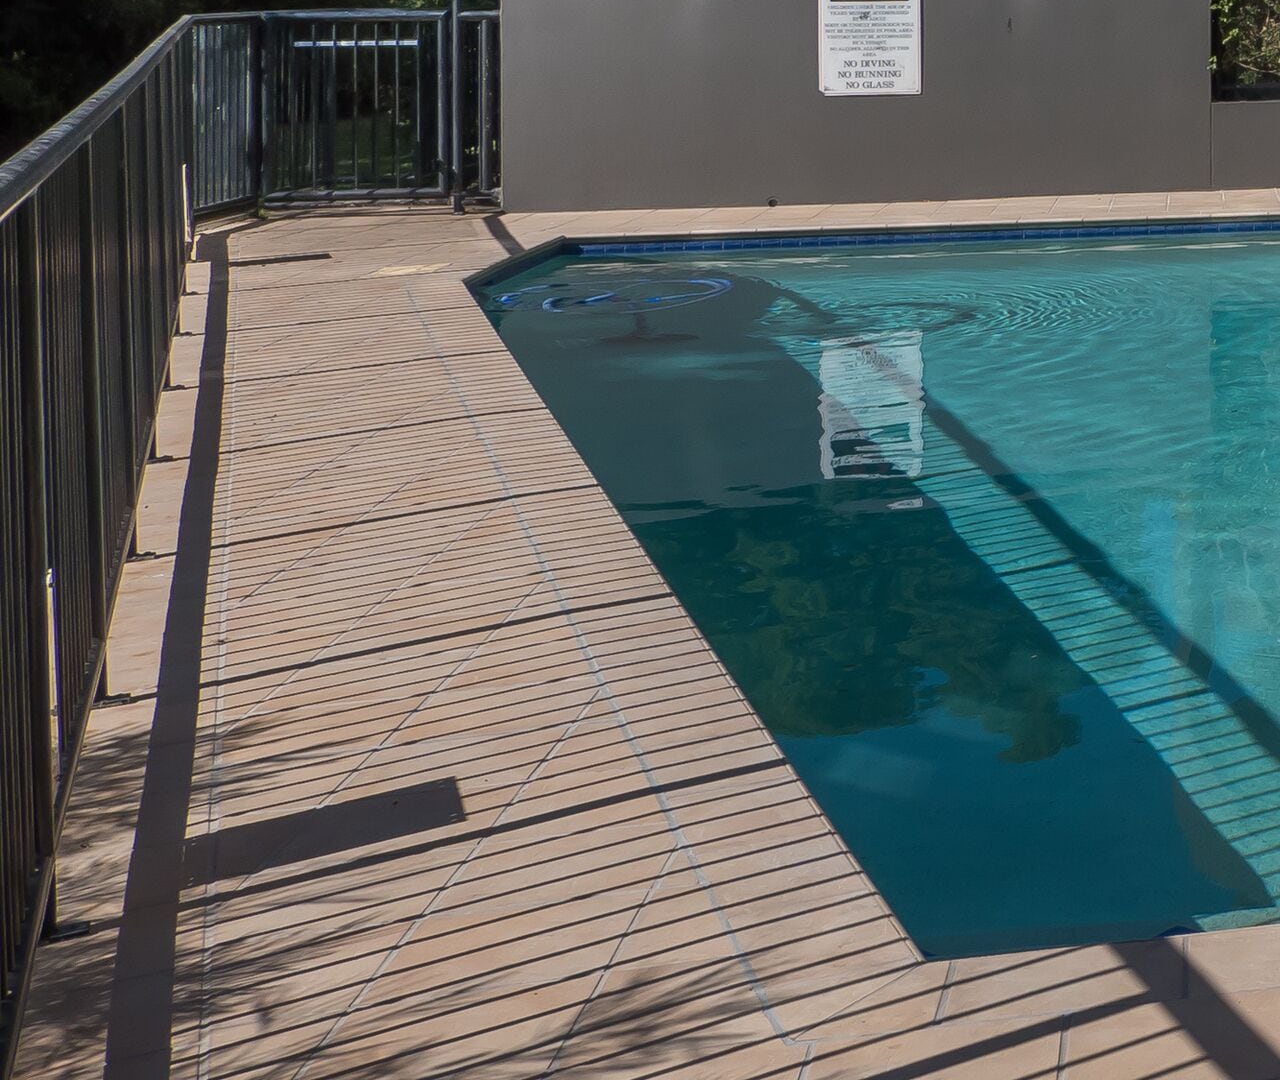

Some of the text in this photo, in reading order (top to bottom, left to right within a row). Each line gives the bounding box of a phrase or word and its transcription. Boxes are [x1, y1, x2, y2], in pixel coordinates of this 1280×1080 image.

[861, 60, 896, 68] DIVING
[838, 70, 902, 78] NO RUNNING
